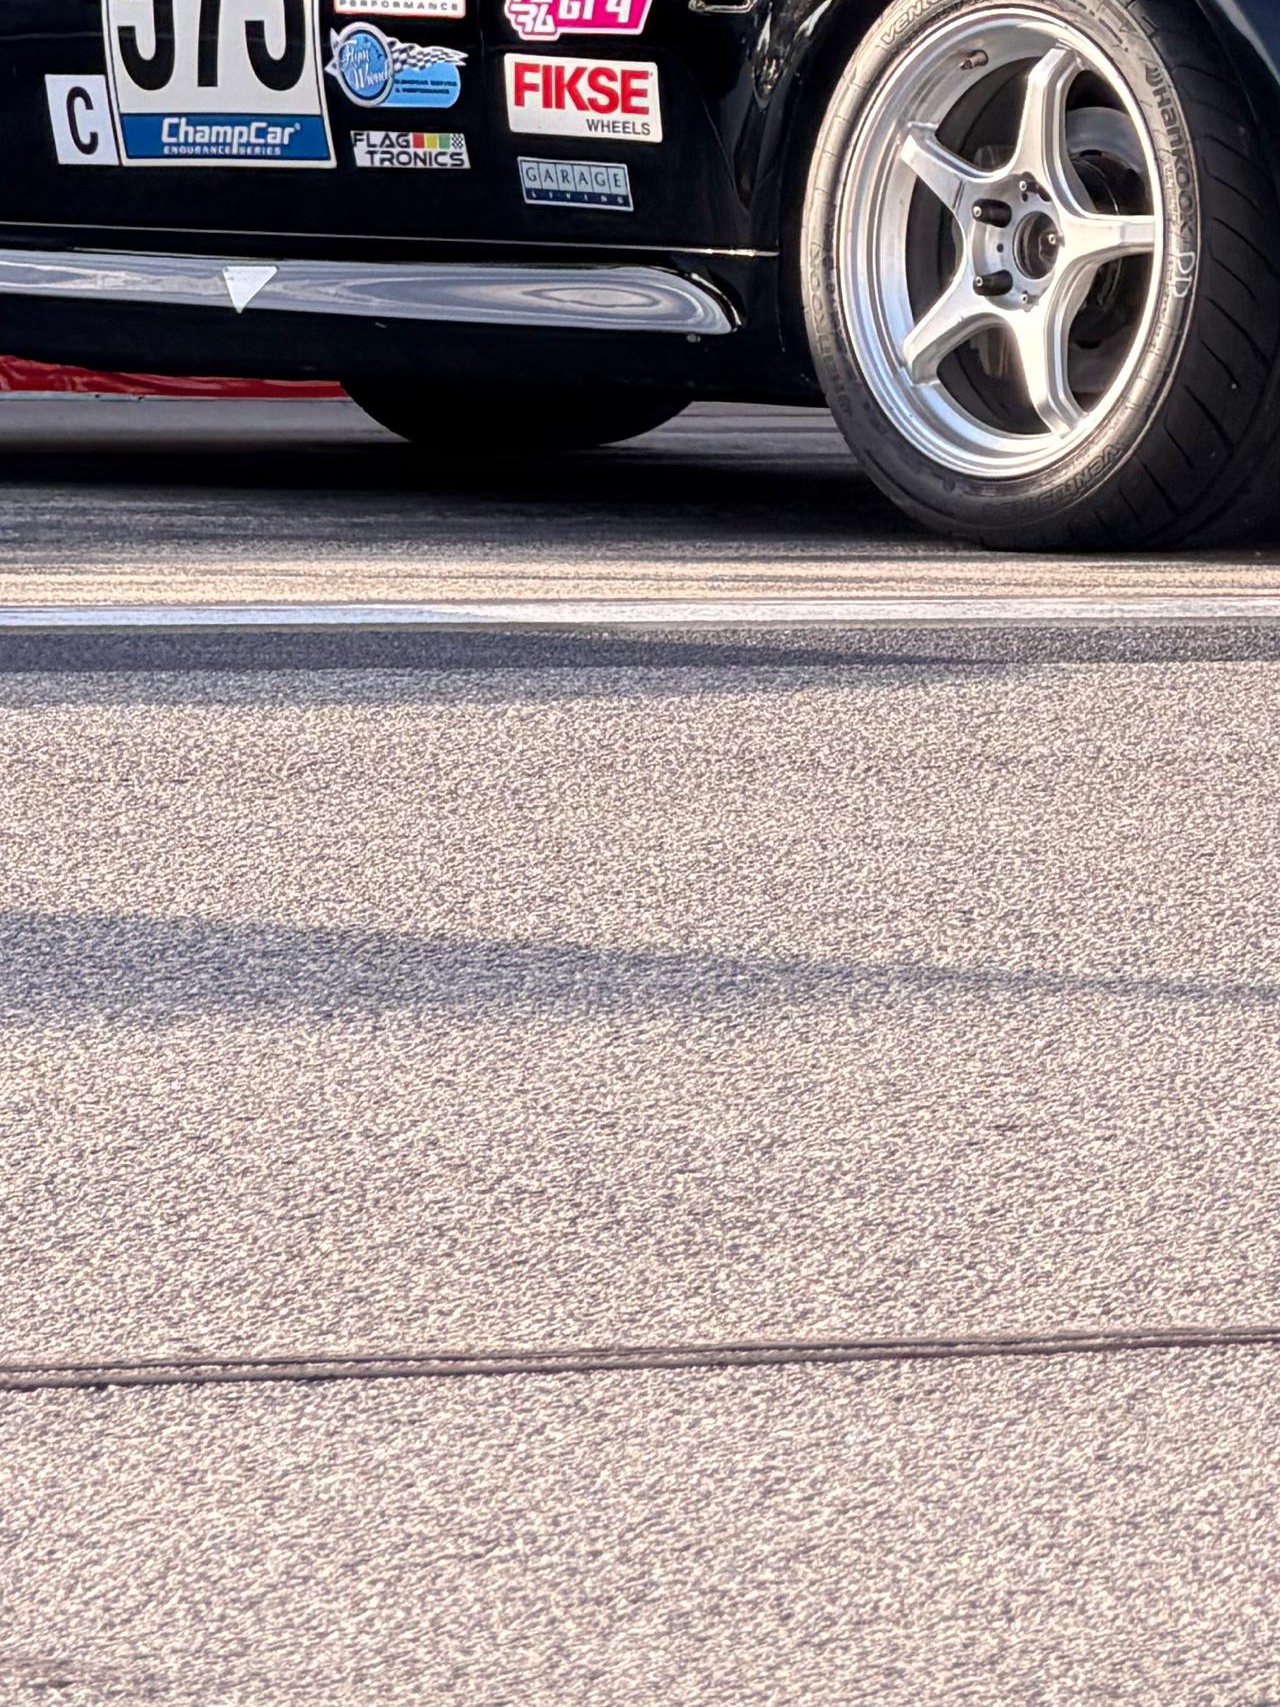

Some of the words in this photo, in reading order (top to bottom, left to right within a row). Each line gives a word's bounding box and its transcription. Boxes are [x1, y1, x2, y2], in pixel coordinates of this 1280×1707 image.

[514, 61, 650, 116] FIKSE
[66, 86, 99, 156] C
[585, 117, 651, 136] WHEELS
[162, 117, 295, 155] ChampCar
[352, 131, 411, 149] FLAG
[163, 145, 233, 155] ENDURANCE
[239, 145, 281, 156] SERIES
[366, 150, 466, 167] TRONICS
[526, 167, 622, 188] GARAGE
